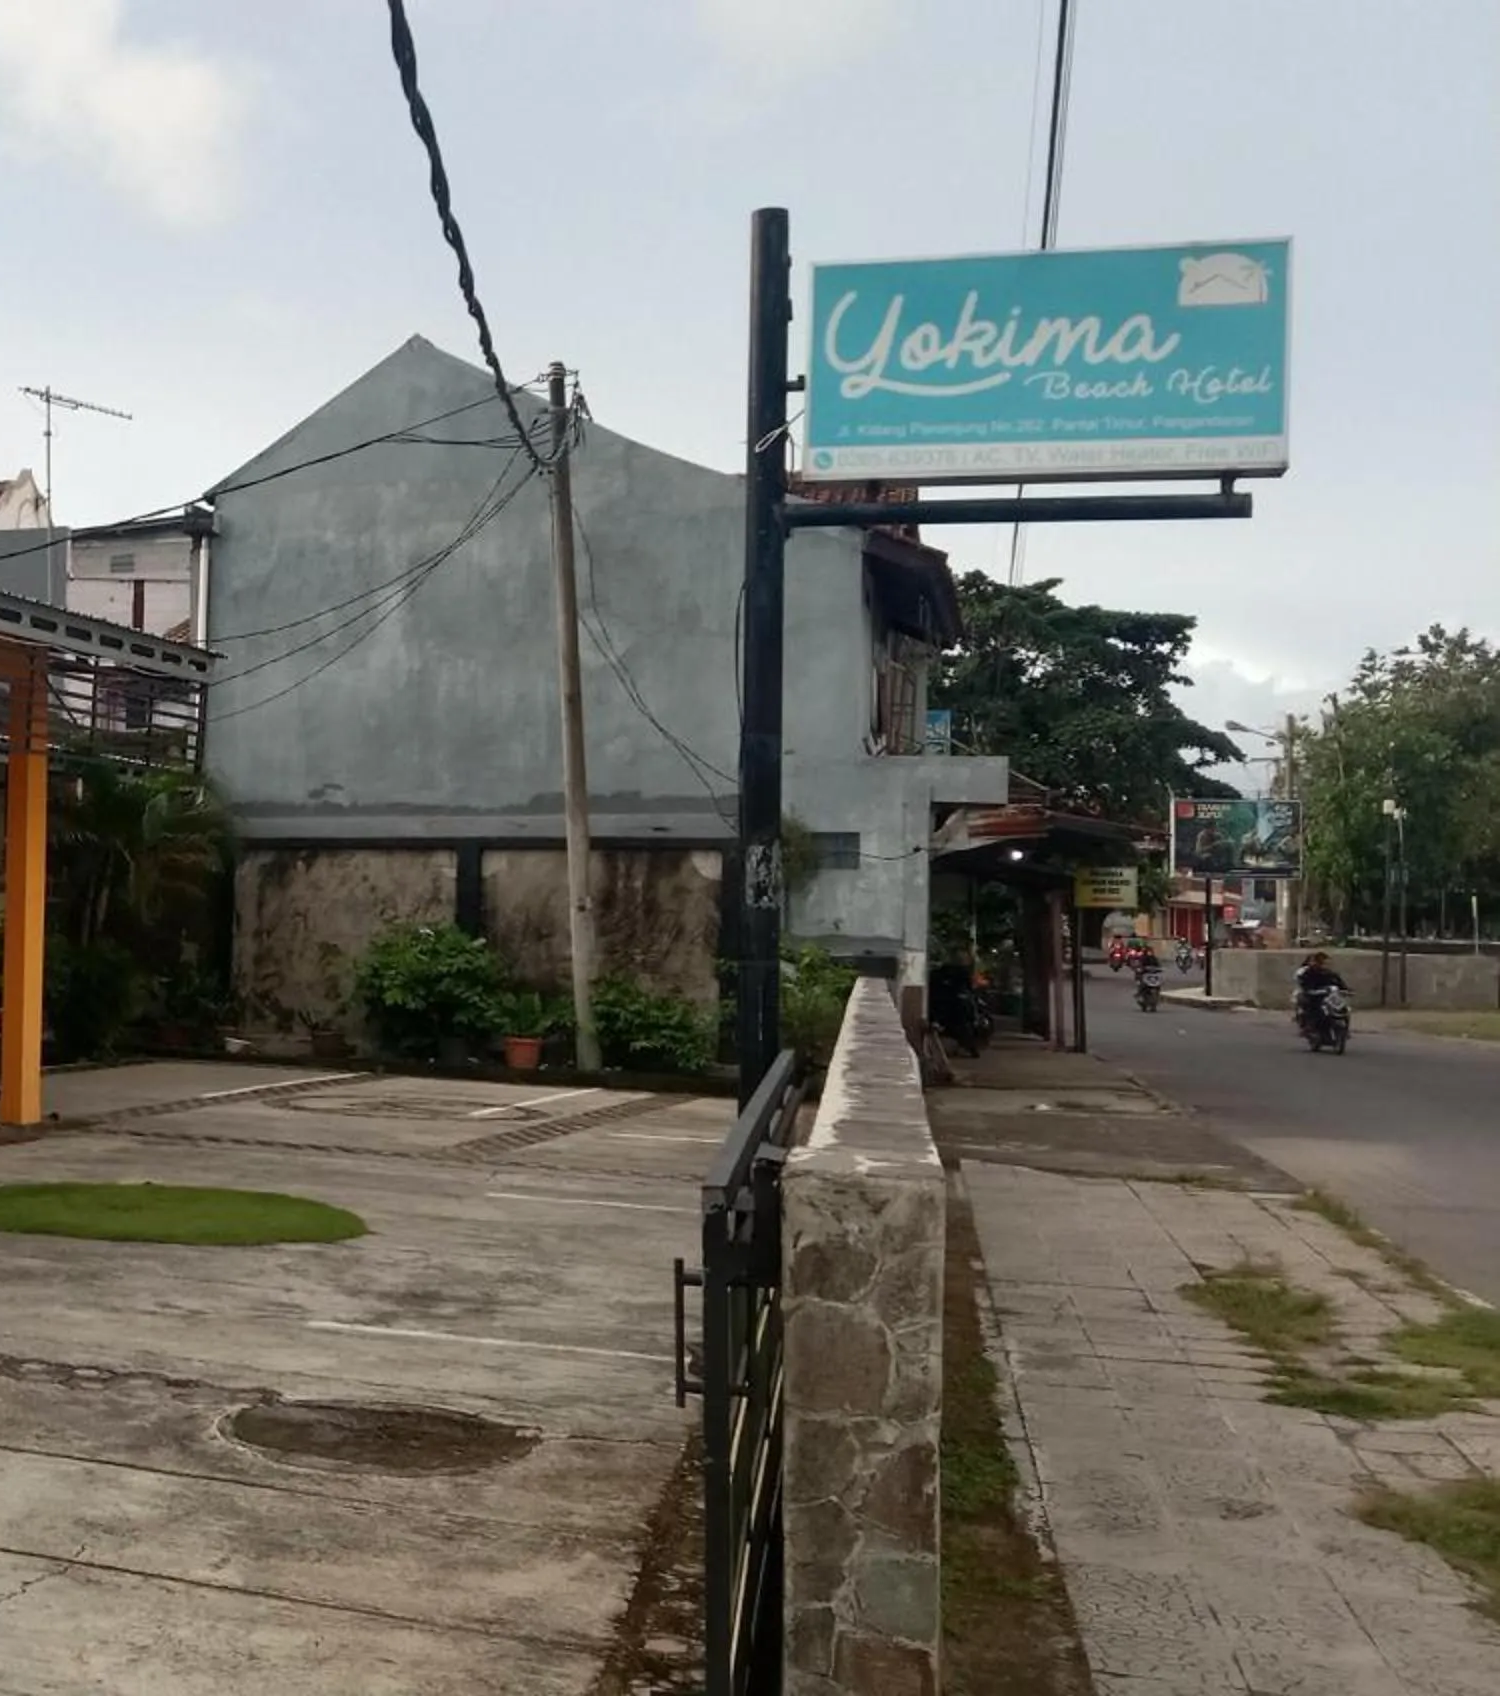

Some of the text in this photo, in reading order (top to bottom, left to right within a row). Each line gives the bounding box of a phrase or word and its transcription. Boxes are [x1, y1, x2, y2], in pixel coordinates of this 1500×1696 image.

[825, 290, 1181, 398] Yokima
[1024, 365, 1276, 404] Beach Hotel
